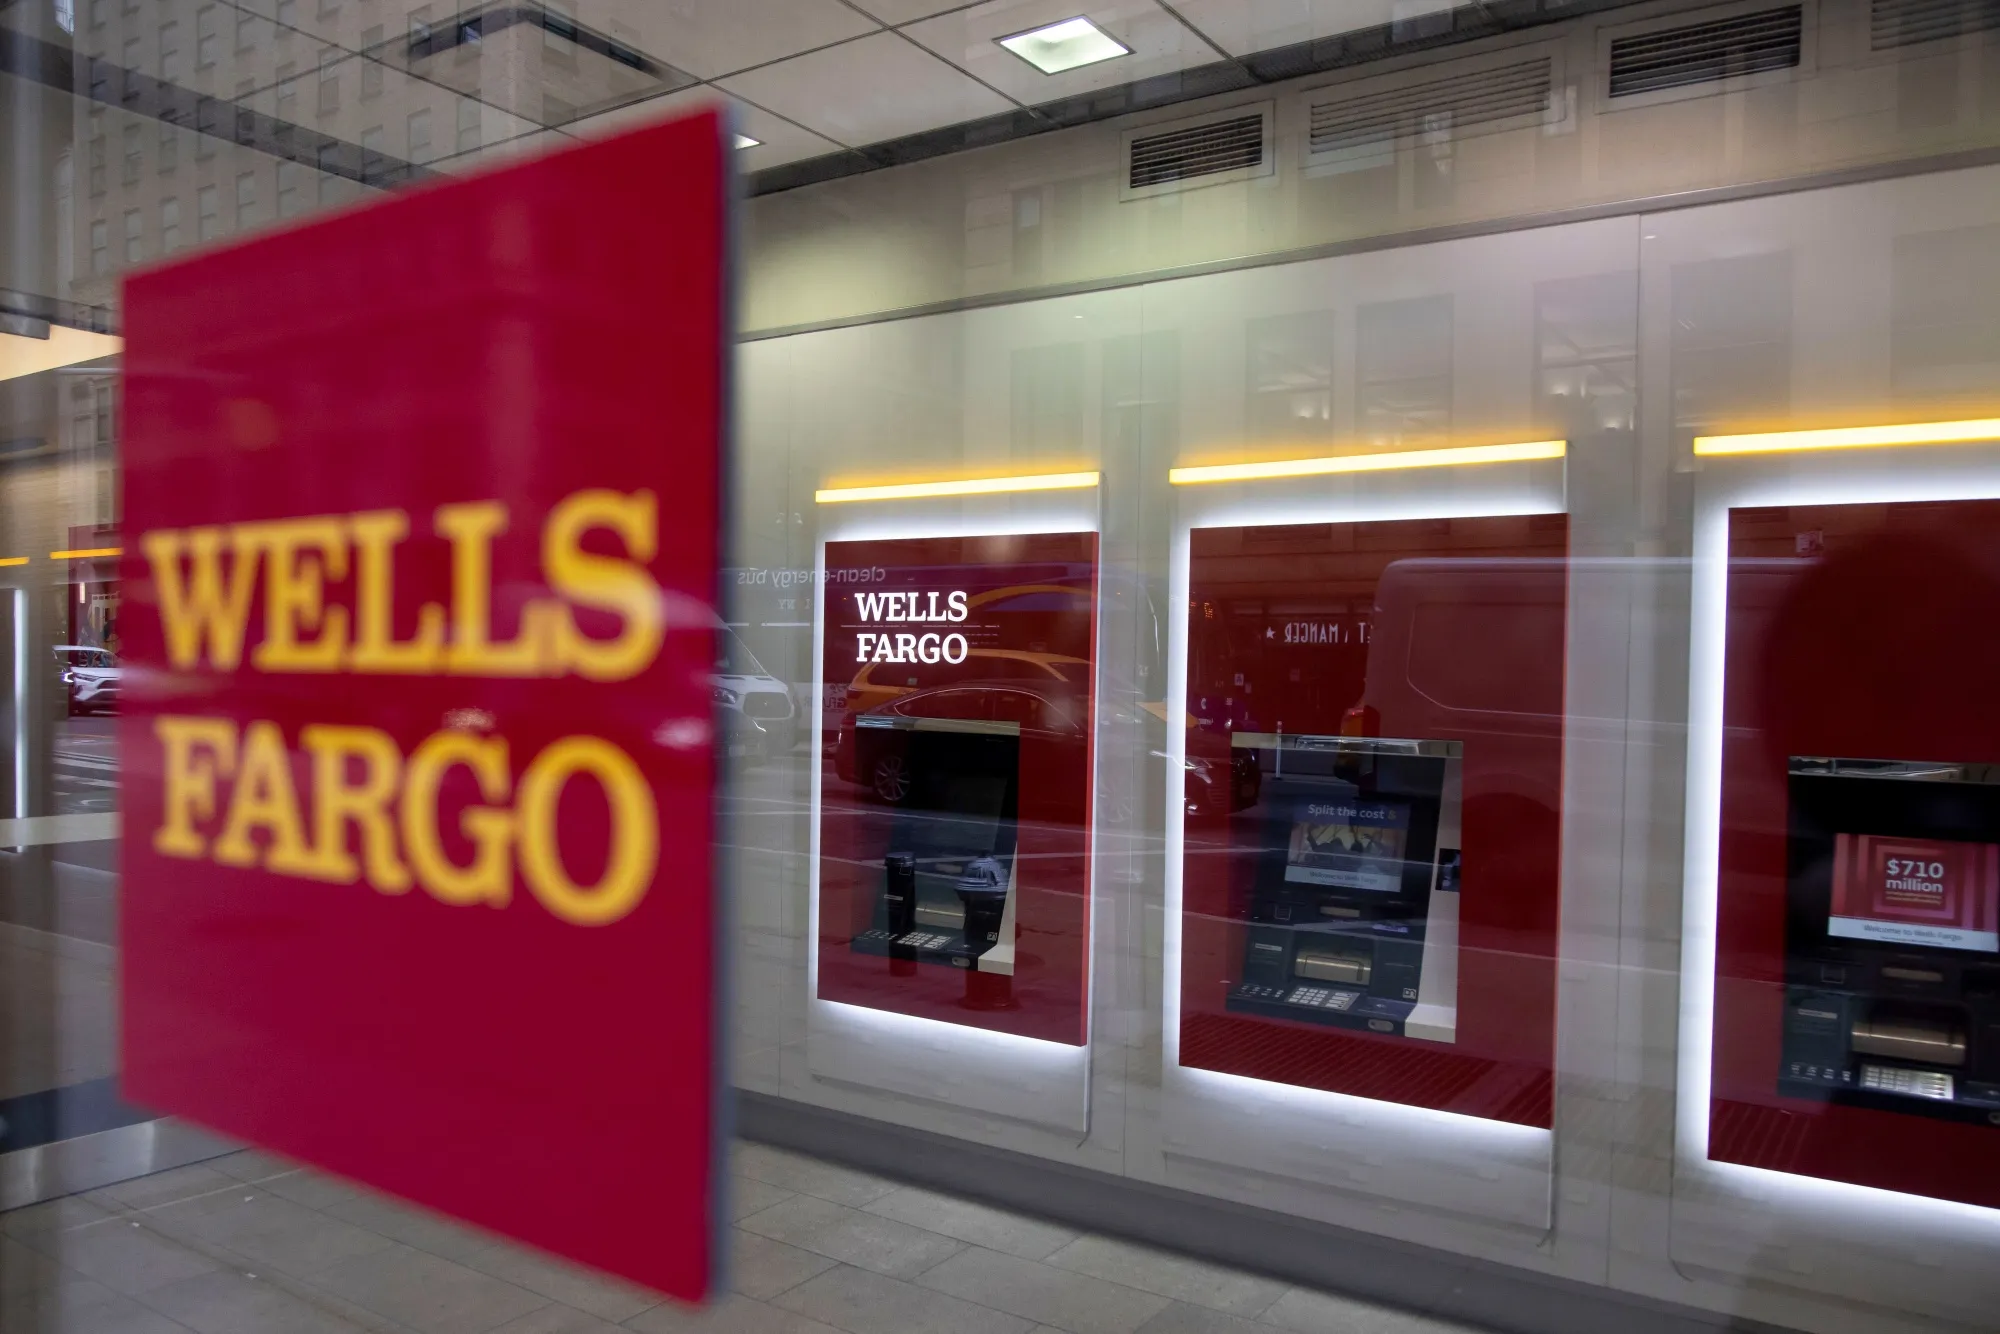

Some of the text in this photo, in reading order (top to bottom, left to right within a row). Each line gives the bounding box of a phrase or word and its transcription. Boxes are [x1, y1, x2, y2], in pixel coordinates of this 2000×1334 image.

[142, 488, 665, 682] WELLS
[854, 591, 968, 622] WELLS
[856, 633, 968, 664] FARGO
[154, 714, 660, 927] FARGO
[1307, 803, 1335, 817] Split
[1337, 806, 1357, 817] the
[1359, 809, 1384, 820] cost
[1887, 858, 1944, 878] $710
[1886, 877, 1943, 893] million
